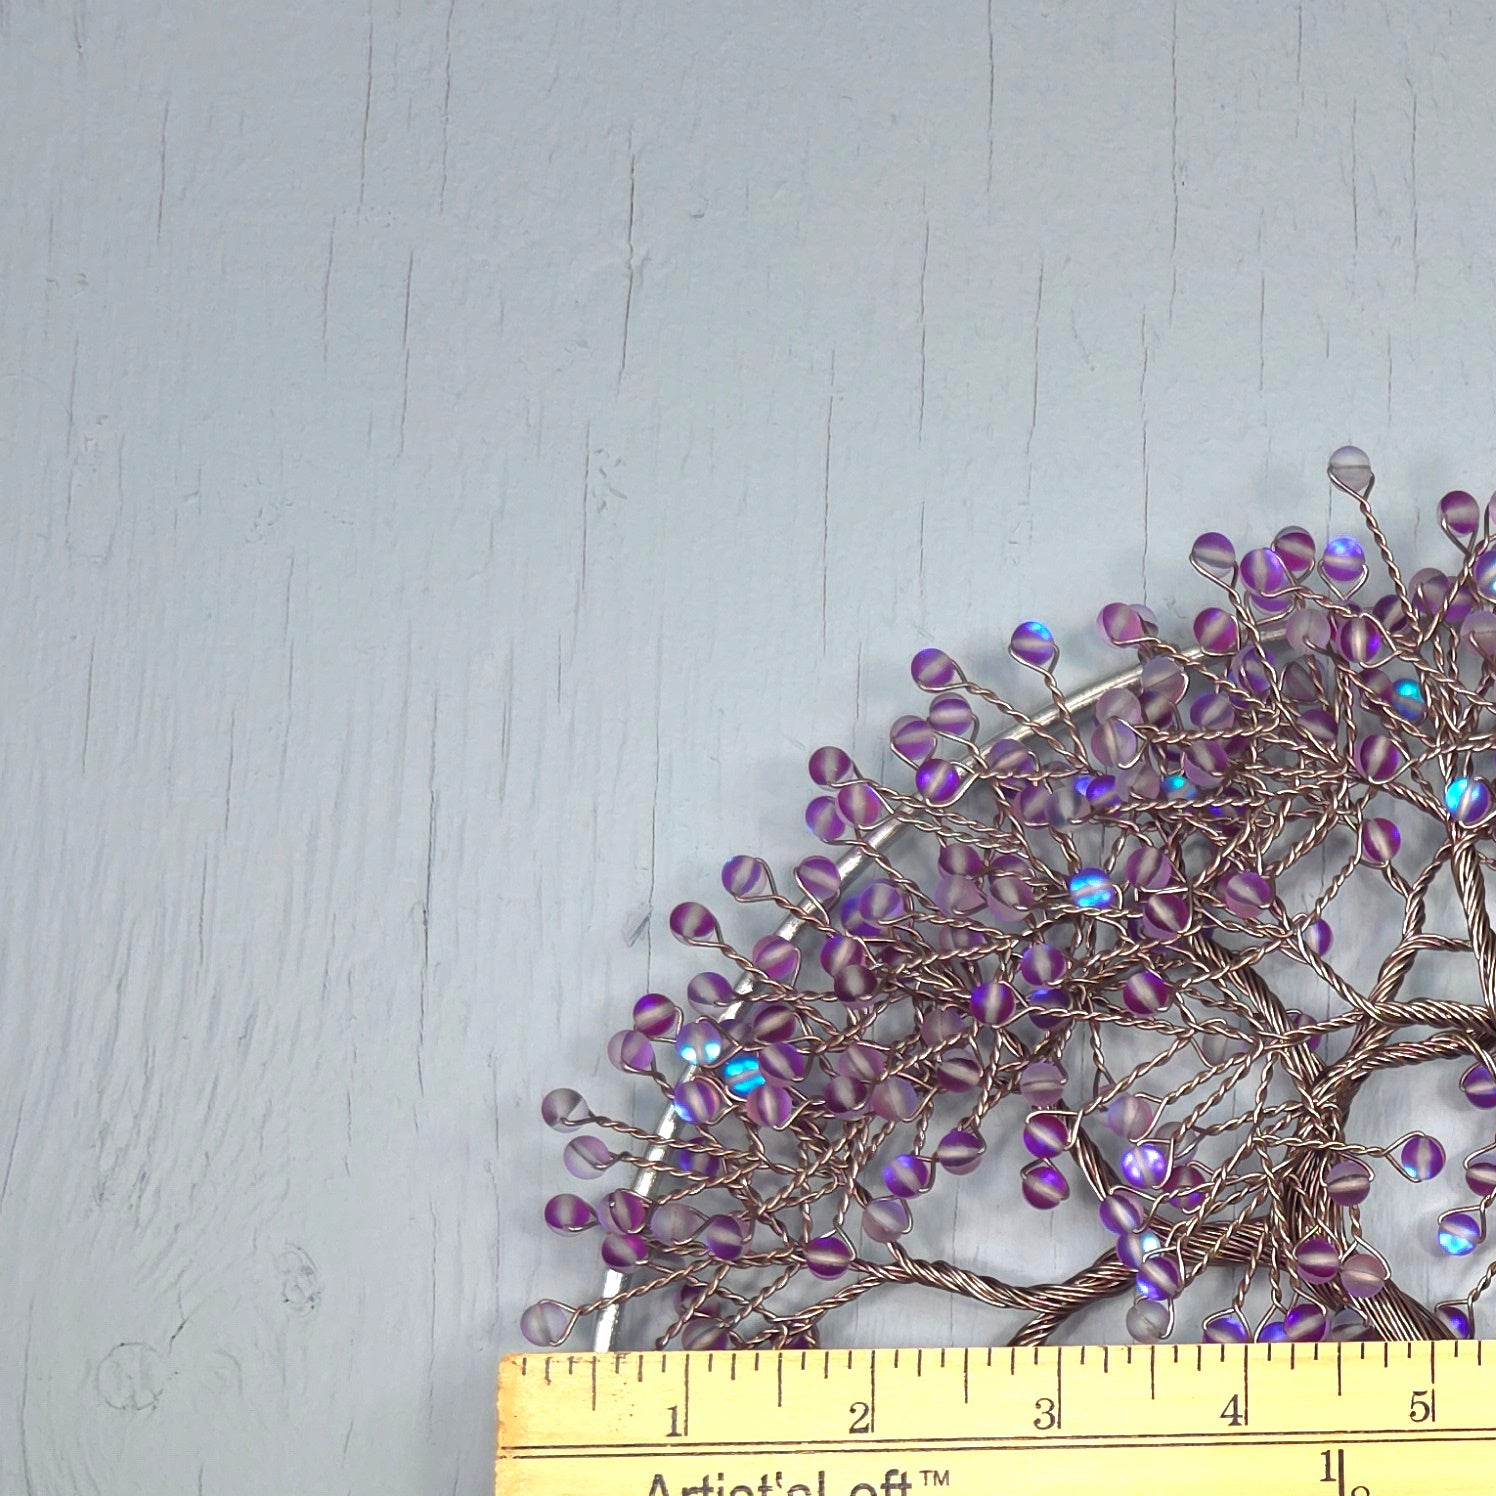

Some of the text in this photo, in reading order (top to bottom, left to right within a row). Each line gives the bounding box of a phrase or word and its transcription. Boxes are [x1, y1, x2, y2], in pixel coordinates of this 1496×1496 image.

[667, 1405, 683, 1437] 1
[848, 1401, 871, 1433] 2
[1032, 1397, 1055, 1430] 3
[1219, 1394, 1243, 1426] 4
[1409, 1390, 1431, 1422] 5
